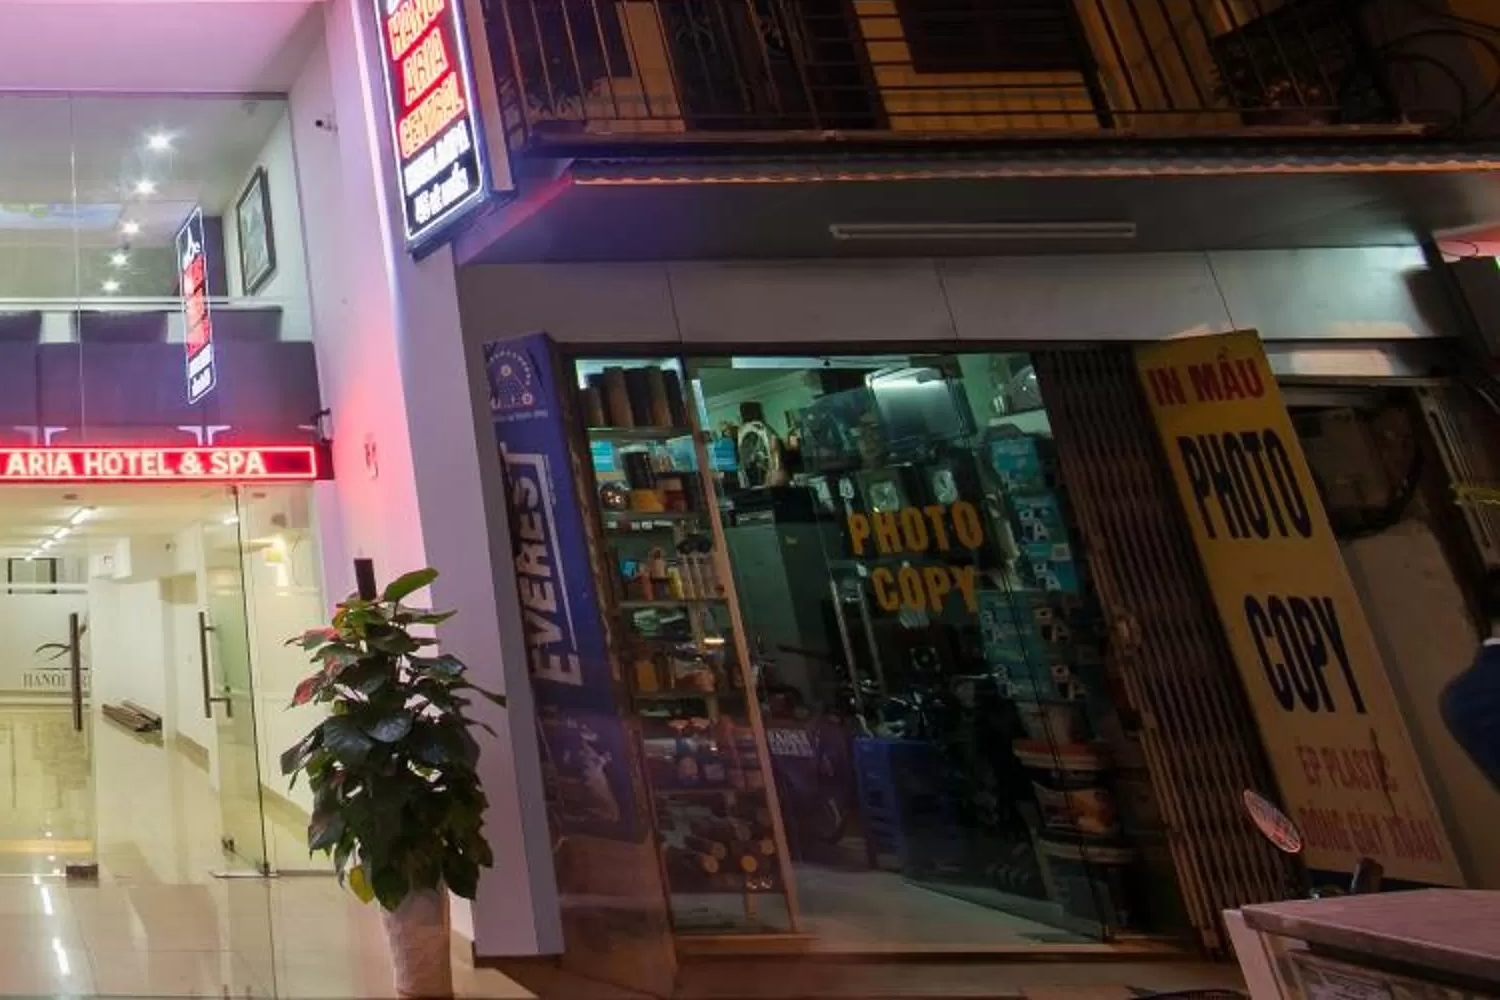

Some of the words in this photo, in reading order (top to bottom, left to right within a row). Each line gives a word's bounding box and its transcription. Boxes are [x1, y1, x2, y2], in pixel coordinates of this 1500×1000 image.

[403, 27, 449, 106] ARIA
[1146, 366, 1188, 406] IN
[11, 450, 72, 476] ARIA
[83, 450, 179, 476] HOTEL
[182, 451, 206, 475] &
[211, 450, 267, 475] SPA
[1176, 429, 1314, 541] PHOTO
[846, 498, 986, 557] PHOTO
[500, 441, 584, 686] EVEREST
[870, 563, 980, 616] COPY
[1244, 594, 1367, 715] COPY
